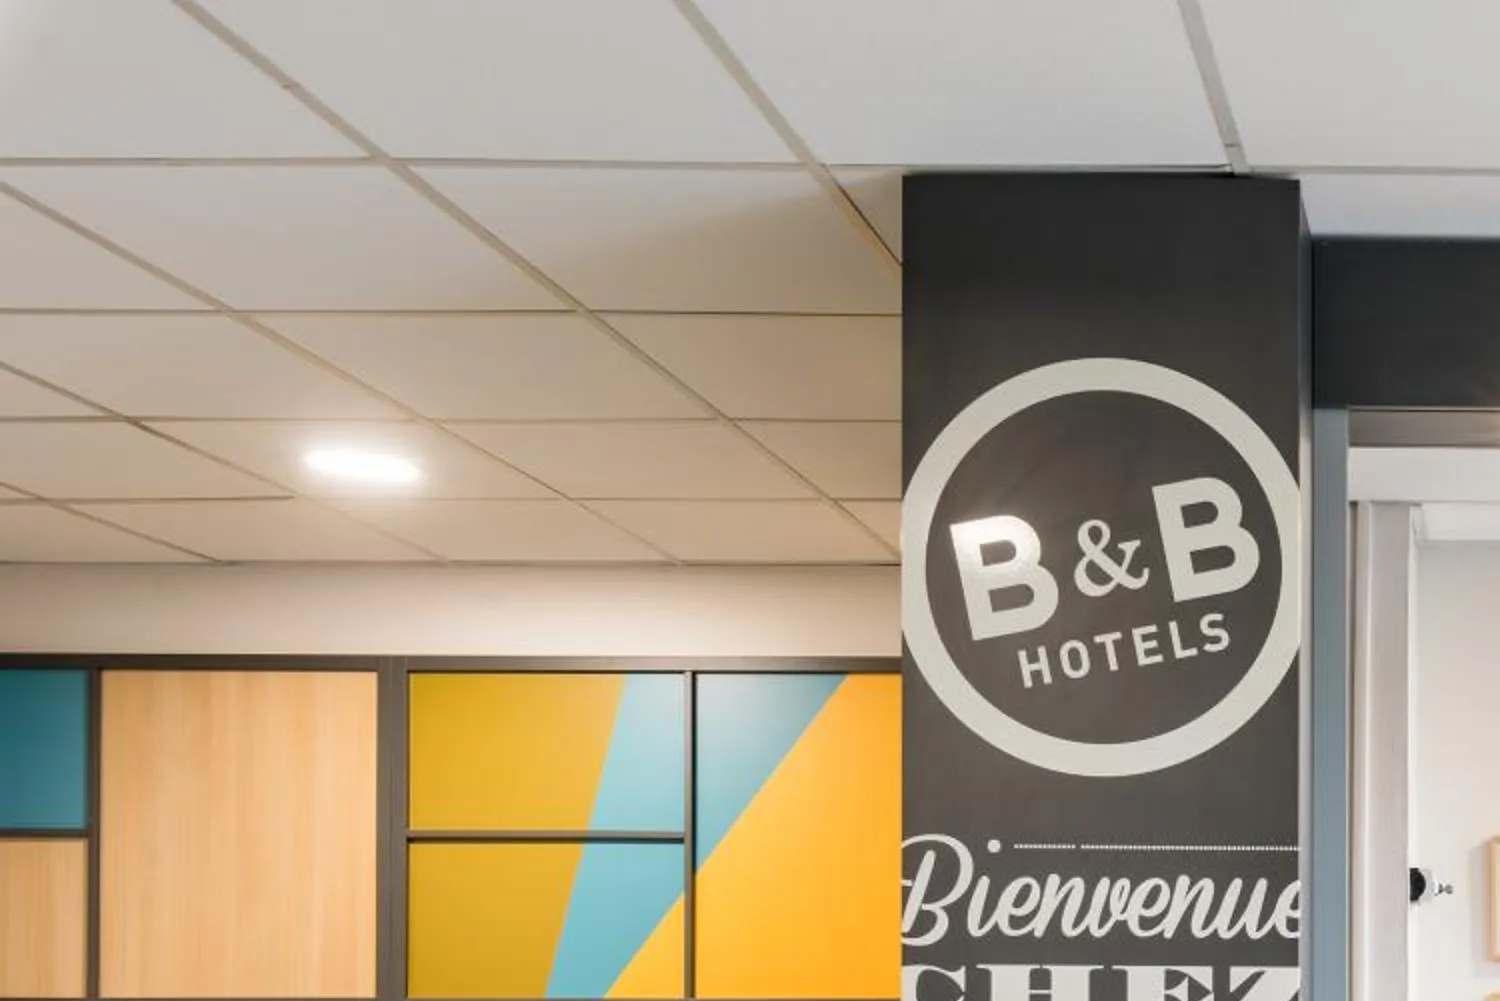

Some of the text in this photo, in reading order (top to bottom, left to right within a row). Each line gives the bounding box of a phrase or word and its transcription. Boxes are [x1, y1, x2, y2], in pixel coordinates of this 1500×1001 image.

[949, 476, 1261, 642] B&B
[1017, 612, 1232, 689] HOTELS
[901, 833, 1299, 947] Bienvenue
